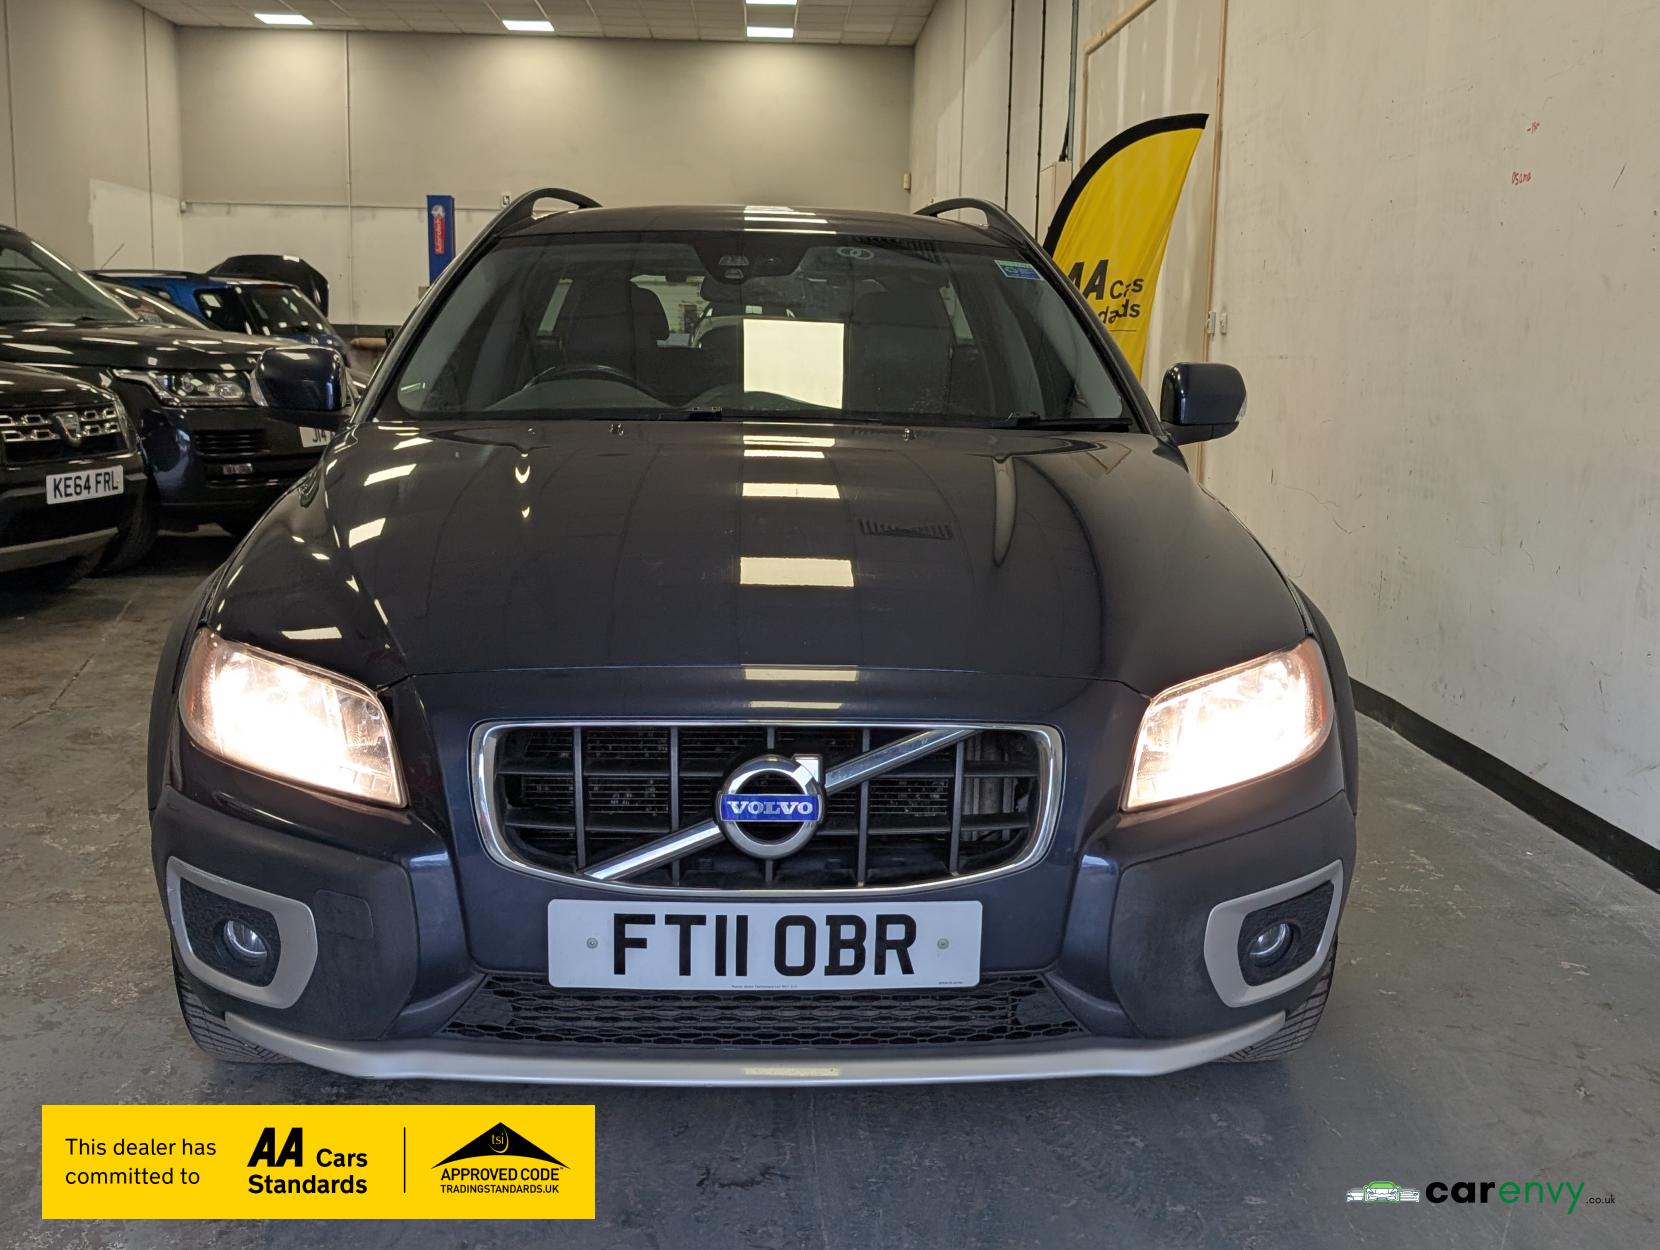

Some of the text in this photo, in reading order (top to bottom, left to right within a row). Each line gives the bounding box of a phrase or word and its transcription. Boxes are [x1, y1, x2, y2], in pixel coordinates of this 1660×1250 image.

[53, 470, 119, 499] KE64 FRL
[727, 800, 813, 815] VOLVO
[613, 913, 917, 976] FT11 OBR
